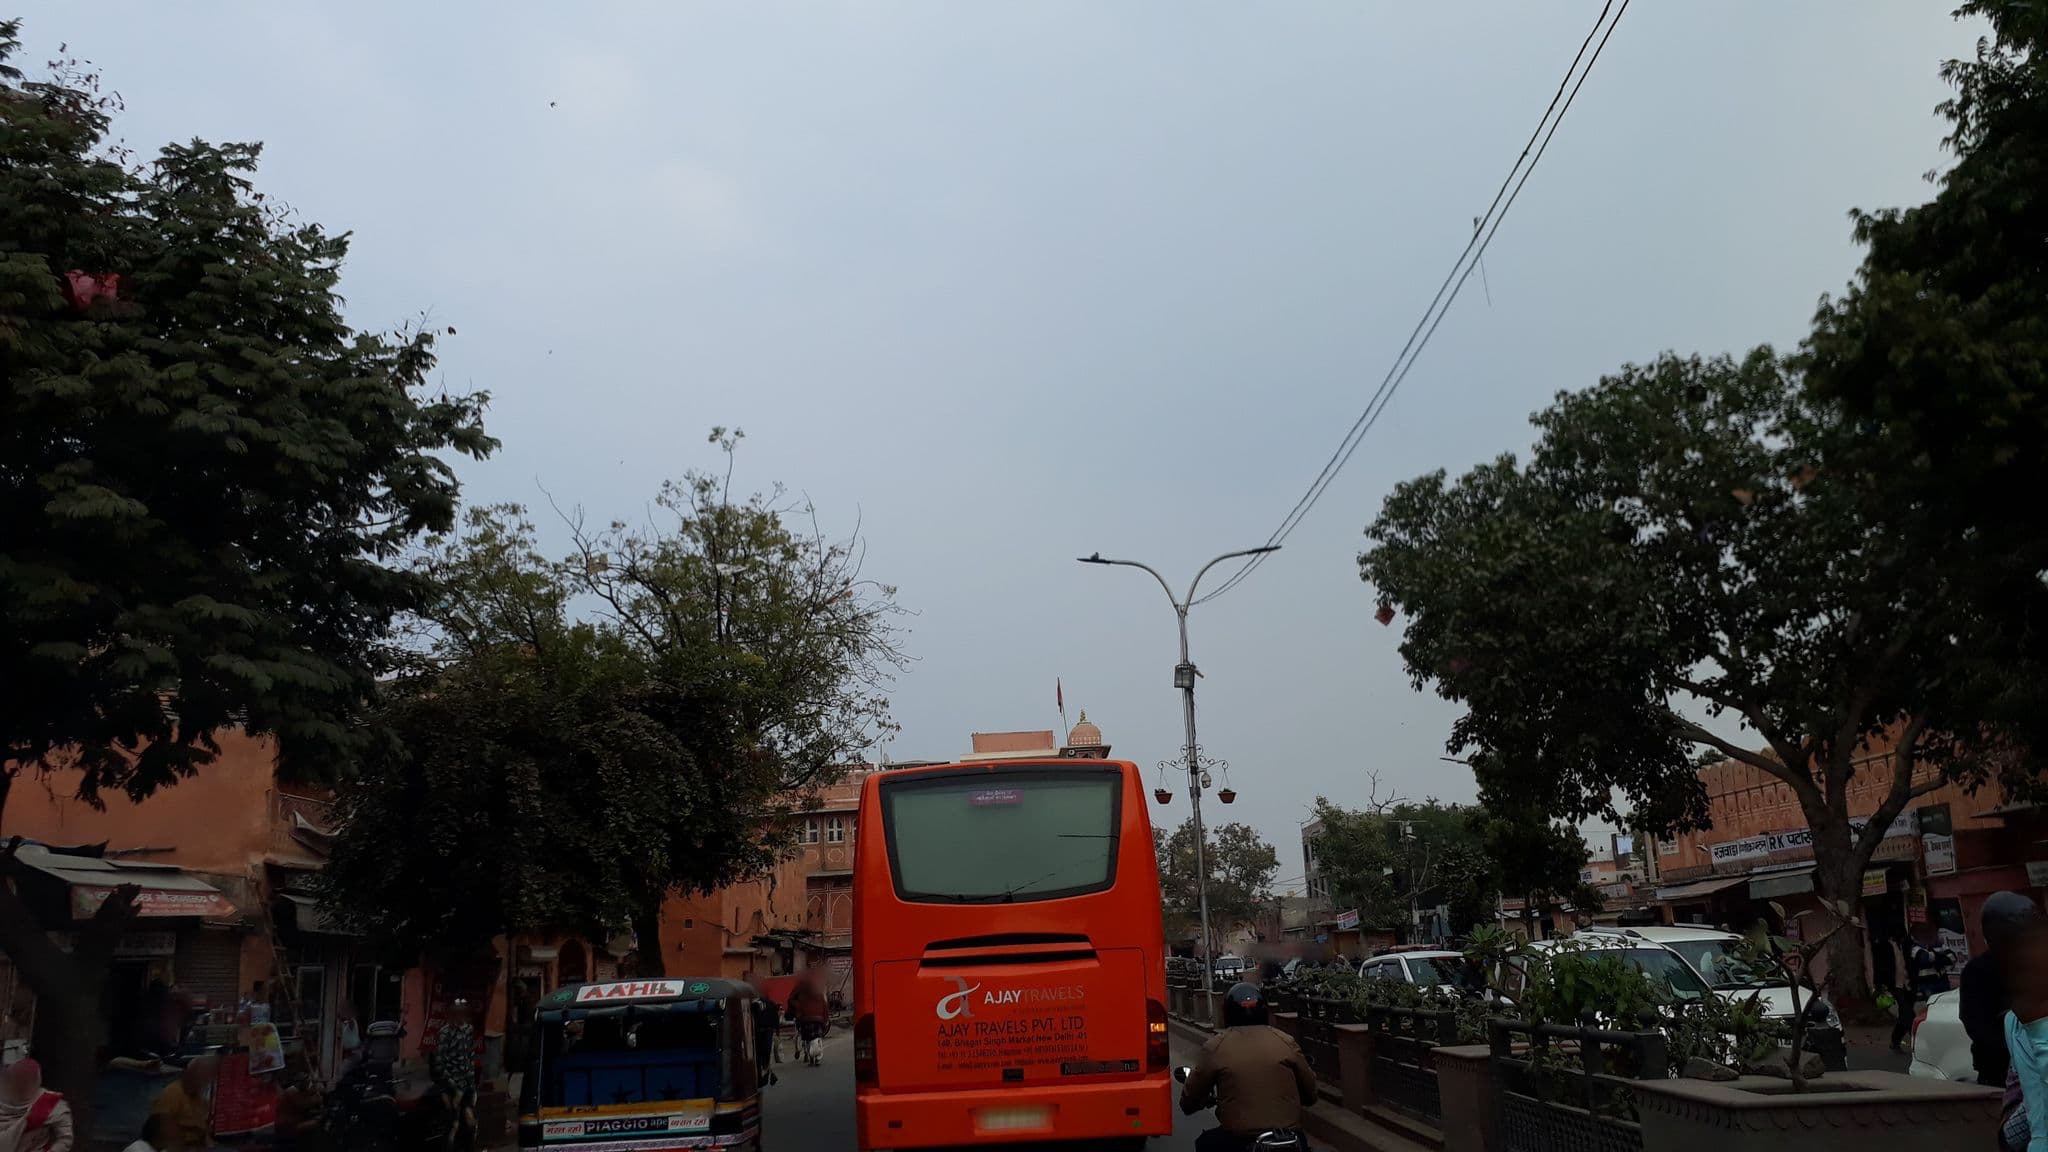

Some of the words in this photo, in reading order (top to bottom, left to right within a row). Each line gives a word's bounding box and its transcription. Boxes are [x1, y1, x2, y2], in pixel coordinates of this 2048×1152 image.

[584, 983, 674, 999] AAHIL
[937, 1023, 969, 1038] AJAY
[975, 1020, 1027, 1036] TRAVELS
[586, 1119, 648, 1132] PIAGGIO
